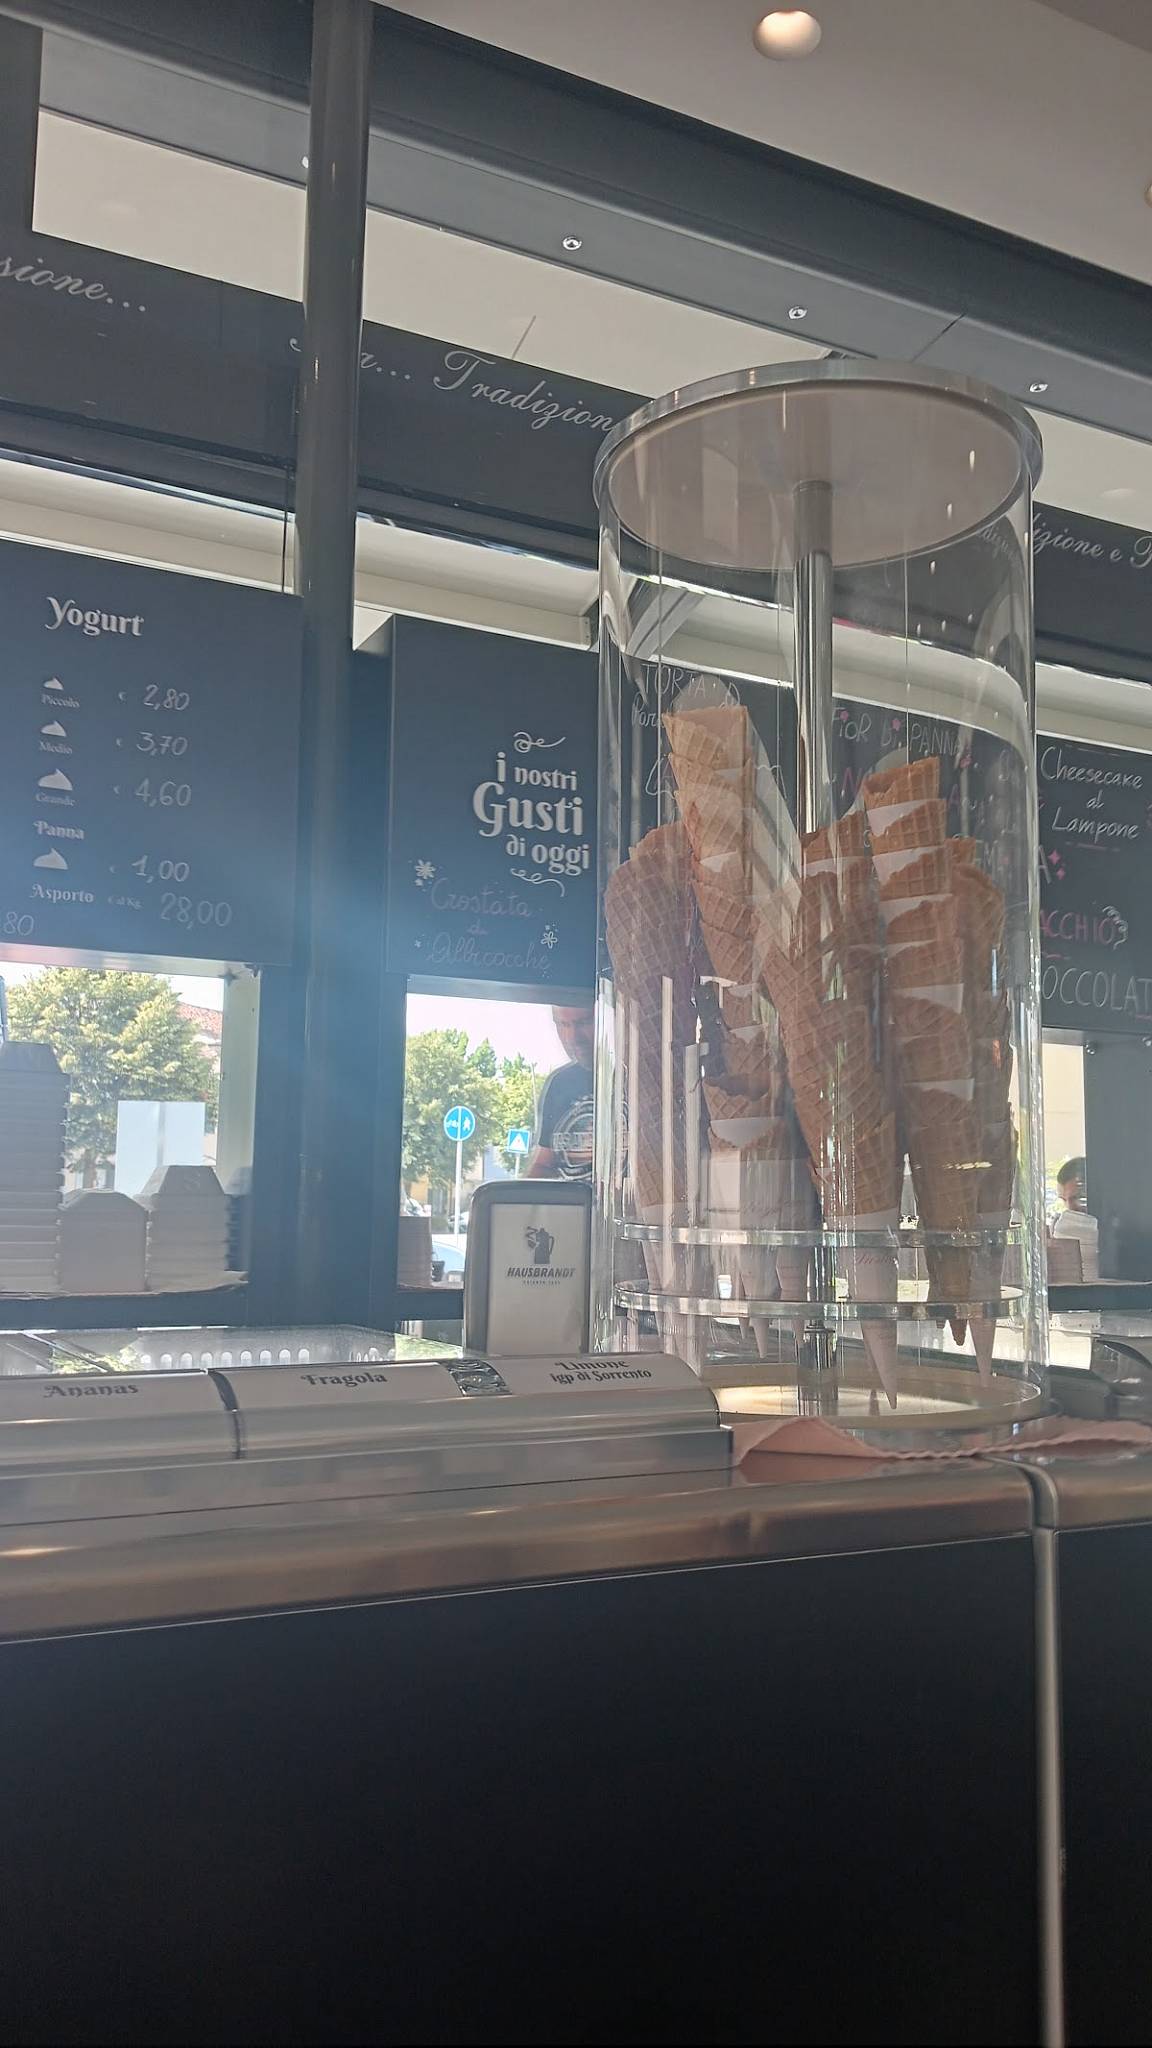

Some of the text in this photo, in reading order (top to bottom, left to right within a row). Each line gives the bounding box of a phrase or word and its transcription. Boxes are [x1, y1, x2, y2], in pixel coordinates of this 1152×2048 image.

[433, 350, 617, 430] Tradizion
[1110, 548, 1122, 562] e
[45, 597, 144, 636] Yogurt
[143, 684, 191, 711] 2,80
[136, 731, 189, 756] 3,70
[514, 766, 577, 791] nostri
[135, 777, 192, 808] 4,60
[473, 781, 583, 838] Gusti
[33, 820, 84, 840] Panna
[1051, 806, 1139, 844] Lampone
[505, 833, 590, 876] di oggi
[131, 855, 190, 883] 1,00
[28, 883, 96, 905] Asporto
[160, 892, 232, 929] 28,00
[506, 1266, 576, 1278] HAUSBRANDT
[300, 1371, 388, 1388] Fragola
[591, 1368, 653, 1382] Sorrento
[42, 1382, 139, 1399] Ananas
